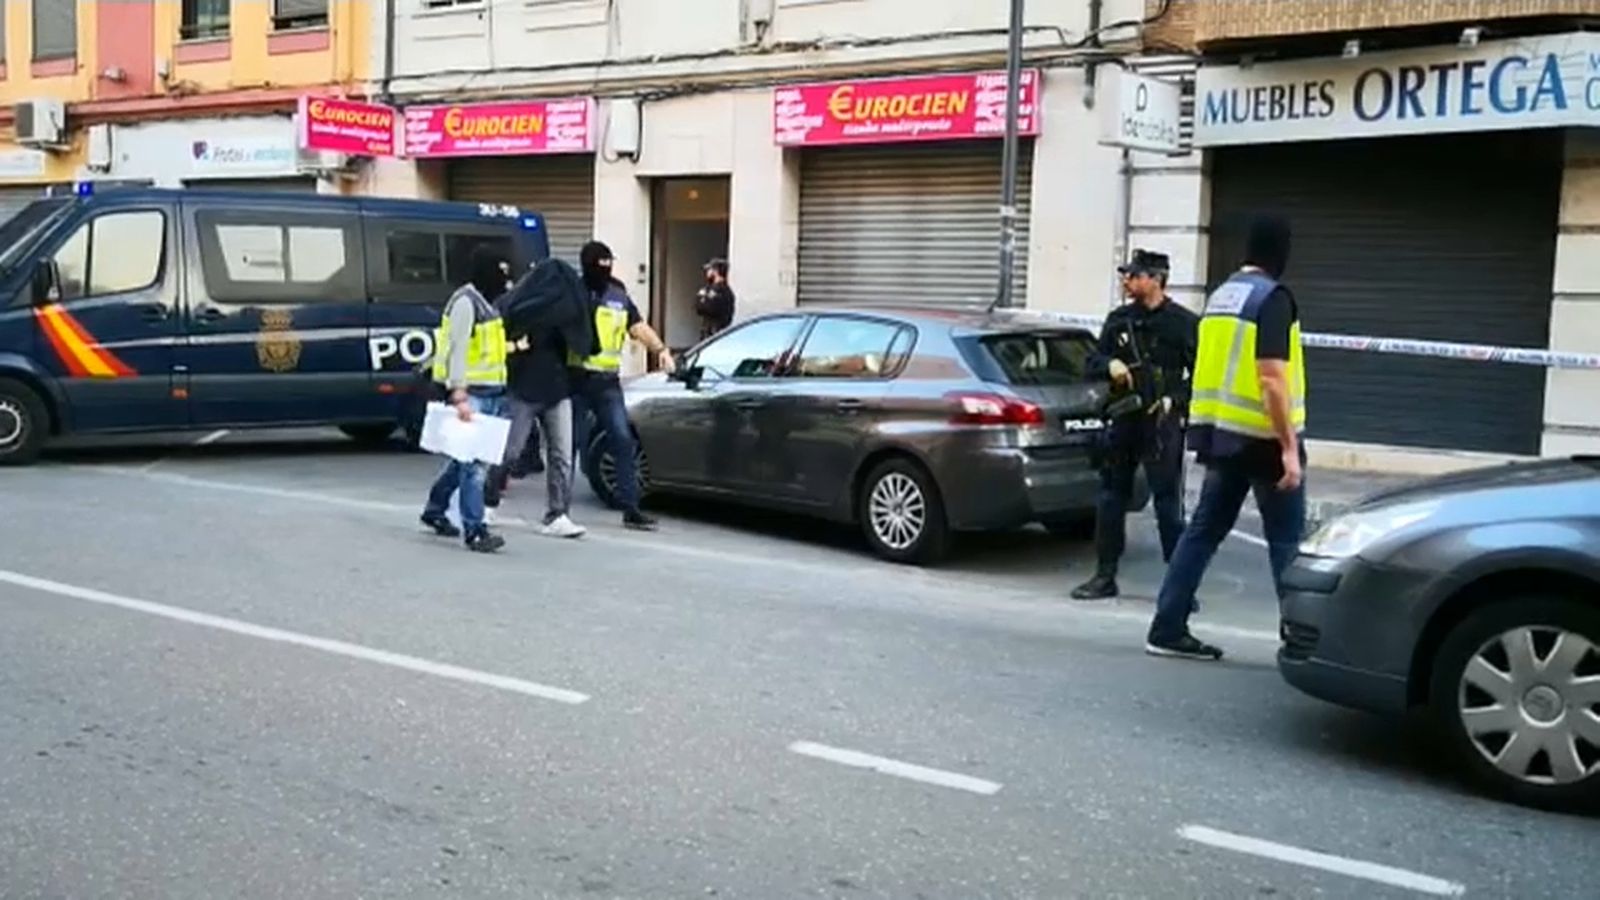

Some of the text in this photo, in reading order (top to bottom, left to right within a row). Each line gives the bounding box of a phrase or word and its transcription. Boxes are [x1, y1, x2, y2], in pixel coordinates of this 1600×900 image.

[1202, 79, 1335, 126] MUEBLES
[1353, 52, 1567, 122] ORTEGA
[369, 329, 439, 370] PO
